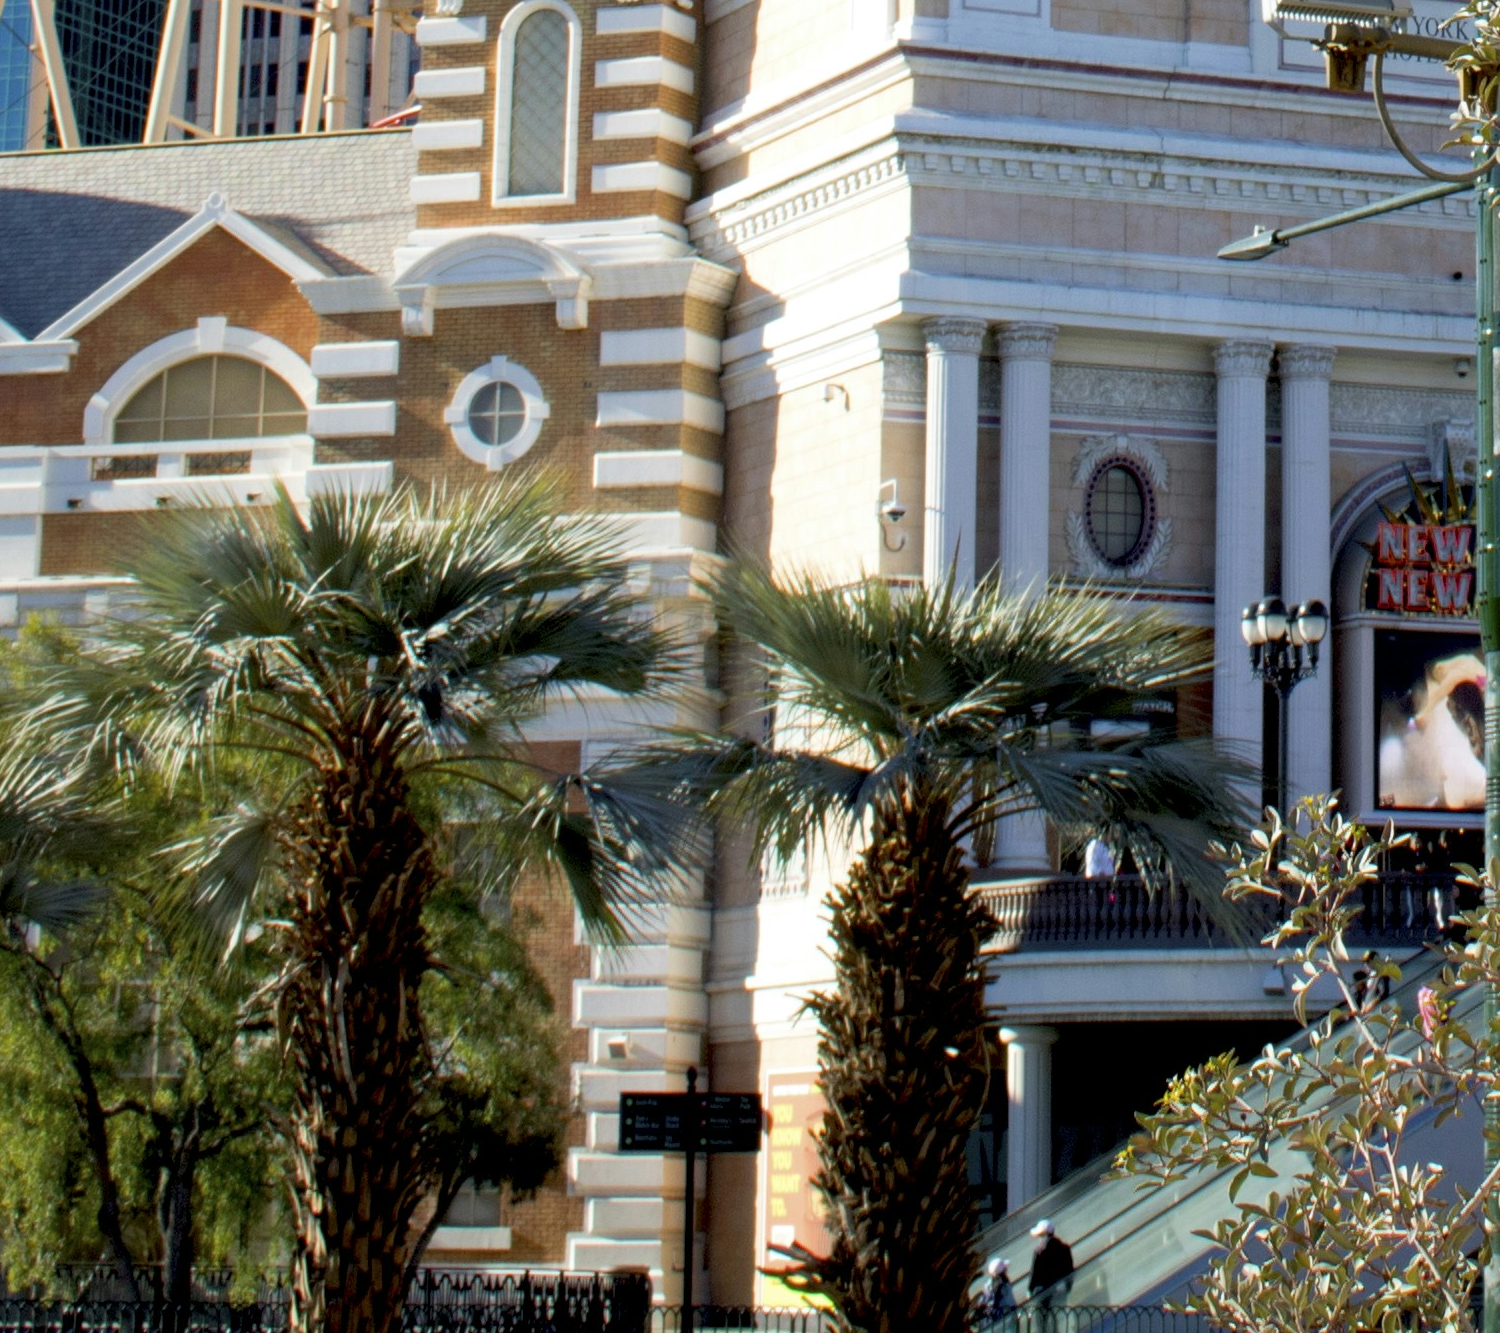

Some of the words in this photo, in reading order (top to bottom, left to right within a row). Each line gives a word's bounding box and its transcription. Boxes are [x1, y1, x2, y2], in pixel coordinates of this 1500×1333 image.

[1412, 16, 1469, 40] YORK
[1379, 523, 1472, 565] NEW
[1379, 568, 1472, 612] NEW
[773, 1104, 793, 1123] YOU
[772, 1151, 793, 1170] YOU
[771, 1174, 802, 1193] WANT
